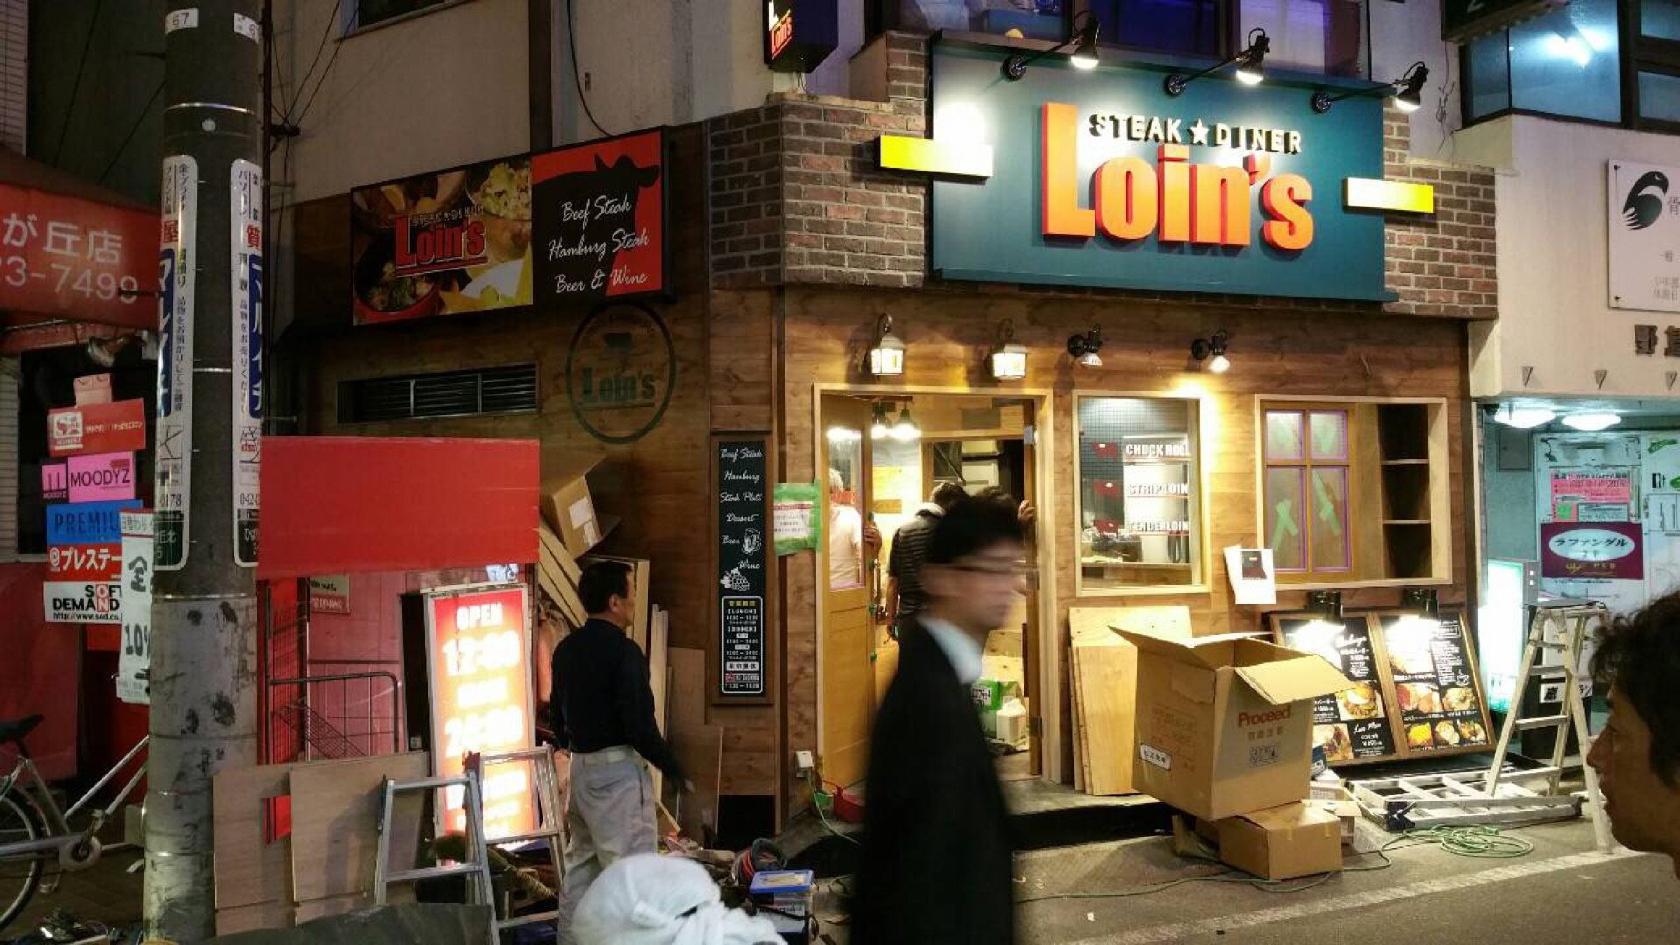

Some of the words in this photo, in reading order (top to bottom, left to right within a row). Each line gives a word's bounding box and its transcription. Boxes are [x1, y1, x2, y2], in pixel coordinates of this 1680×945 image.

[1089, 113, 1182, 143] STEAK
[1214, 122, 1302, 154] DINER
[1042, 102, 1313, 250] Loin's
[561, 199, 590, 230] Beef
[593, 193, 632, 216] Steak
[3, 213, 123, 264] が丘店
[394, 213, 487, 268] Loin's
[548, 238, 607, 262] Hamburg
[611, 226, 650, 252] Steak
[0, 254, 138, 305] 3-7499
[554, 272, 585, 295] Beer
[591, 269, 605, 290] &
[609, 264, 650, 286] Wine
[70, 469, 130, 487] MOODYZ
[52, 598, 120, 612] DEMAND
[456, 603, 503, 630] OPEN
[1238, 704, 1292, 728] Proceed
